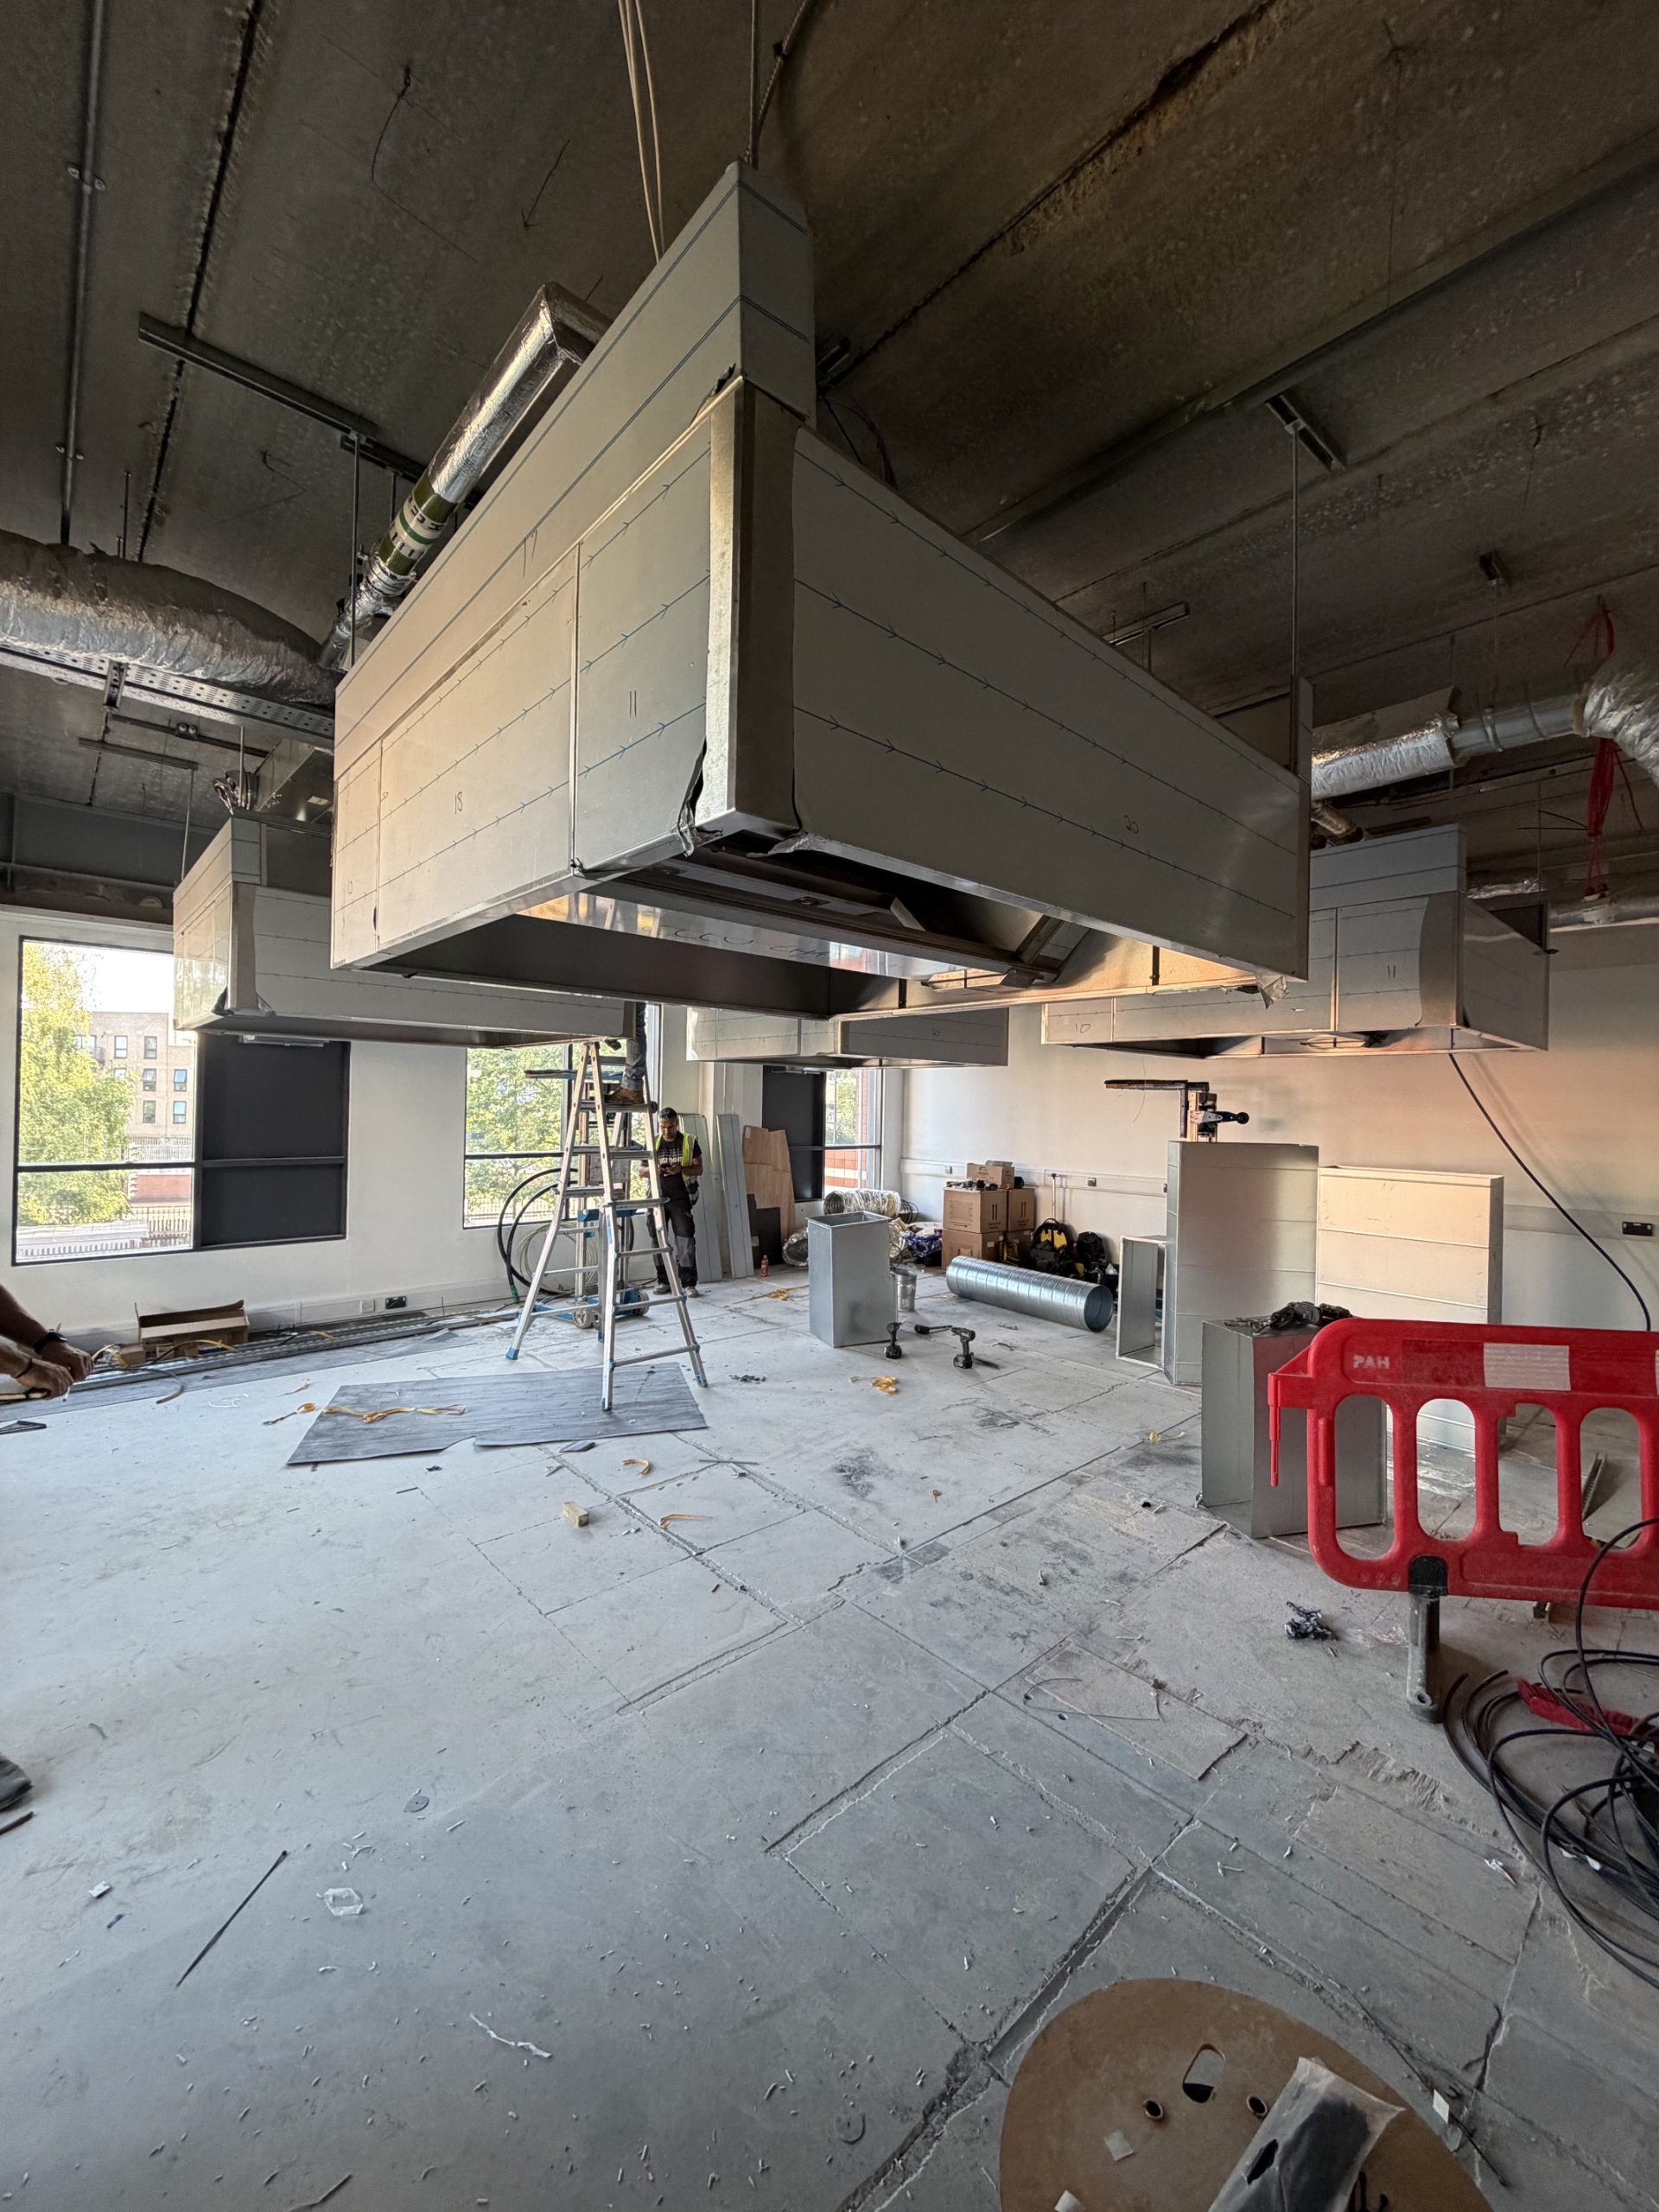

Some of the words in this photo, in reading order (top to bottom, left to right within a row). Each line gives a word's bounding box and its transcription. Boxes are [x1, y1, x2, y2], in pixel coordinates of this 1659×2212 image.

[454, 791, 463, 816] 18
[1123, 815, 1139, 835] 20
[1352, 1355, 1390, 1370] PAH
